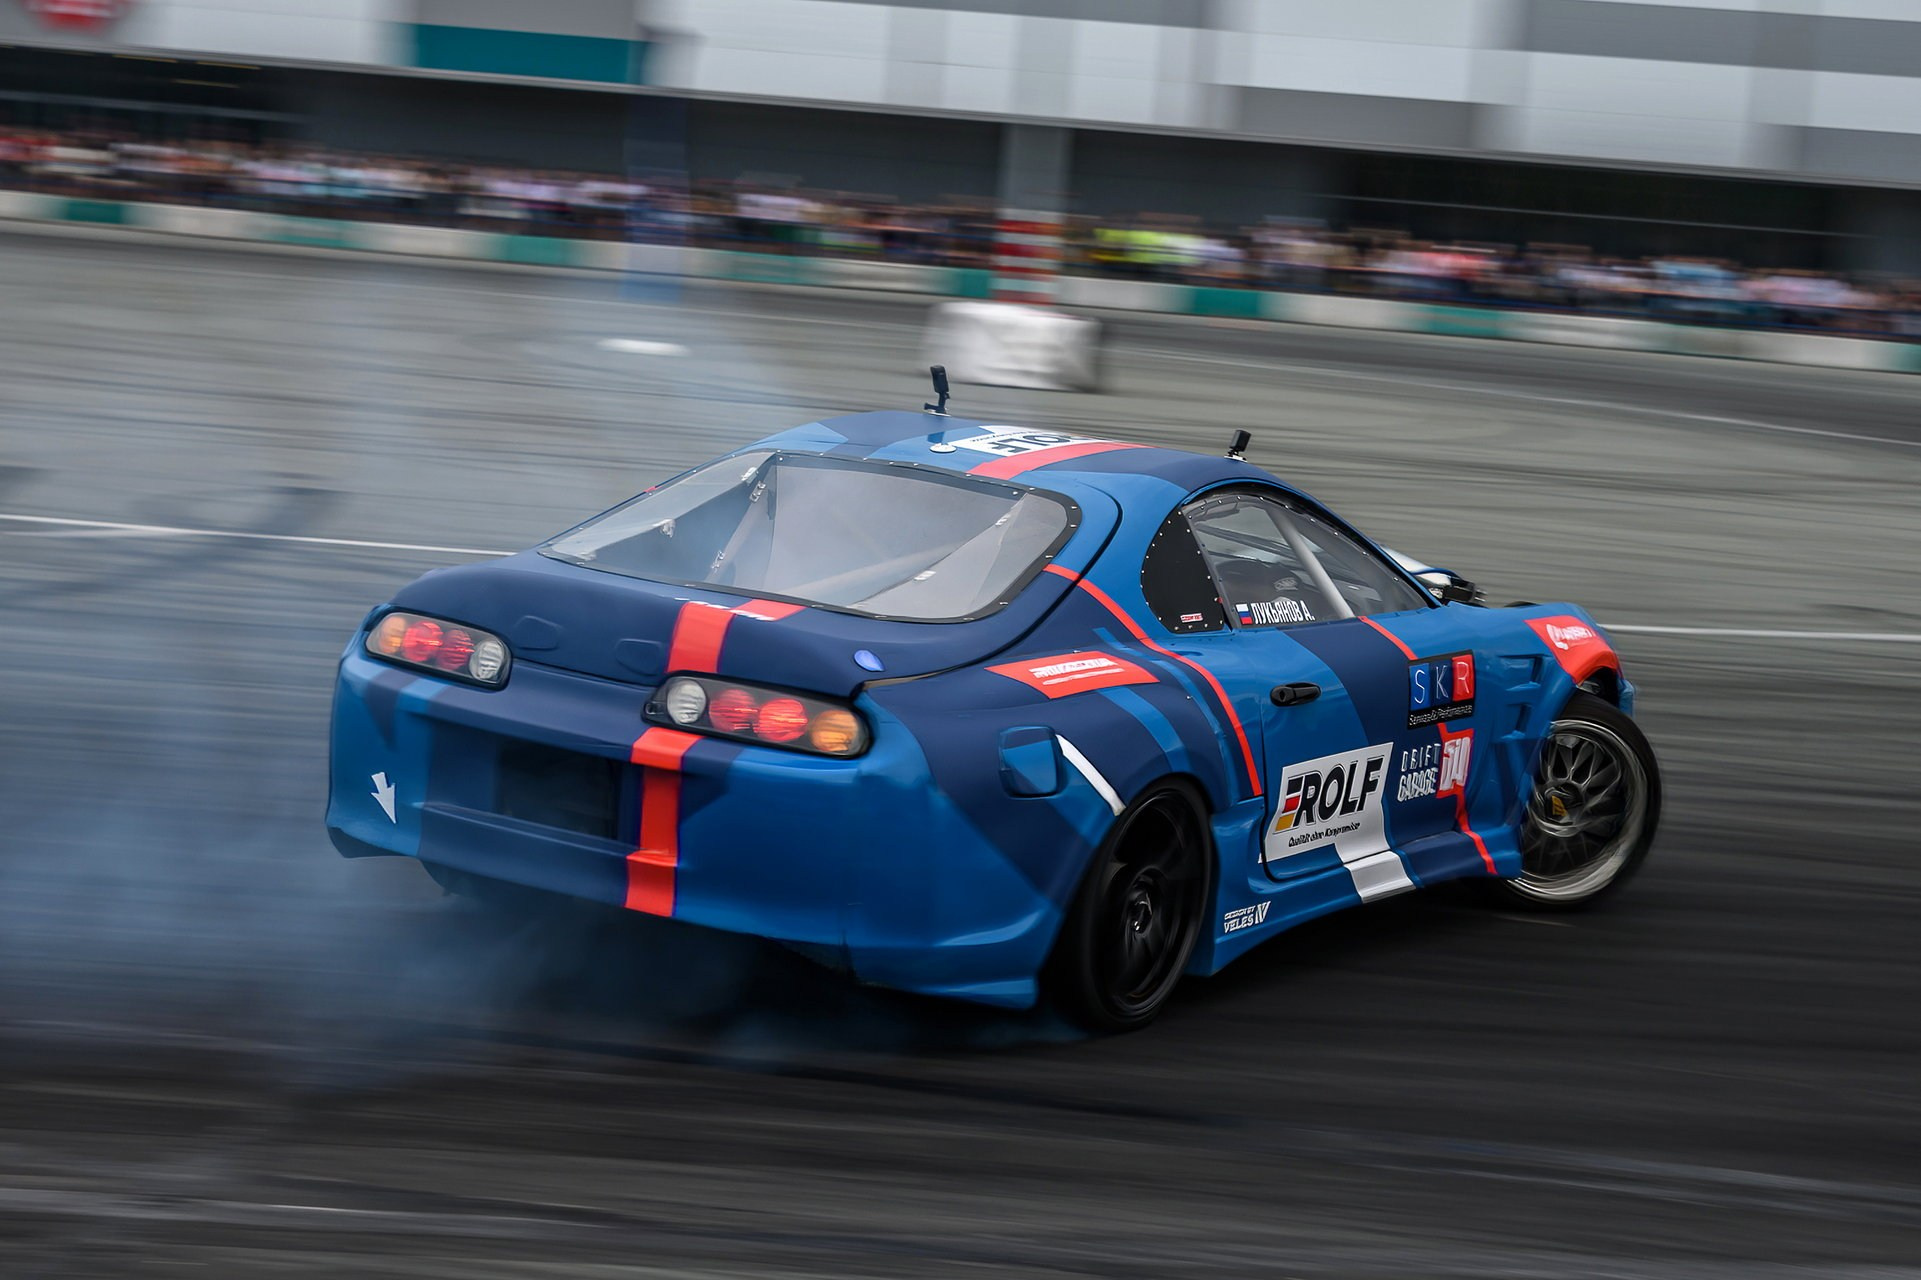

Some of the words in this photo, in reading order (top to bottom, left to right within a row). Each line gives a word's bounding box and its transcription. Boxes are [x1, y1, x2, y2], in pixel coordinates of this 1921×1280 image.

[1251, 601, 1304, 625] ЛУКЬЯНОВ
[1414, 661, 1470, 704] SKR
[1401, 743, 1441, 772] DRIFT
[1293, 755, 1385, 828] ROLF
[1397, 767, 1439, 802] GARAGE
[1224, 914, 1254, 934] VELES
